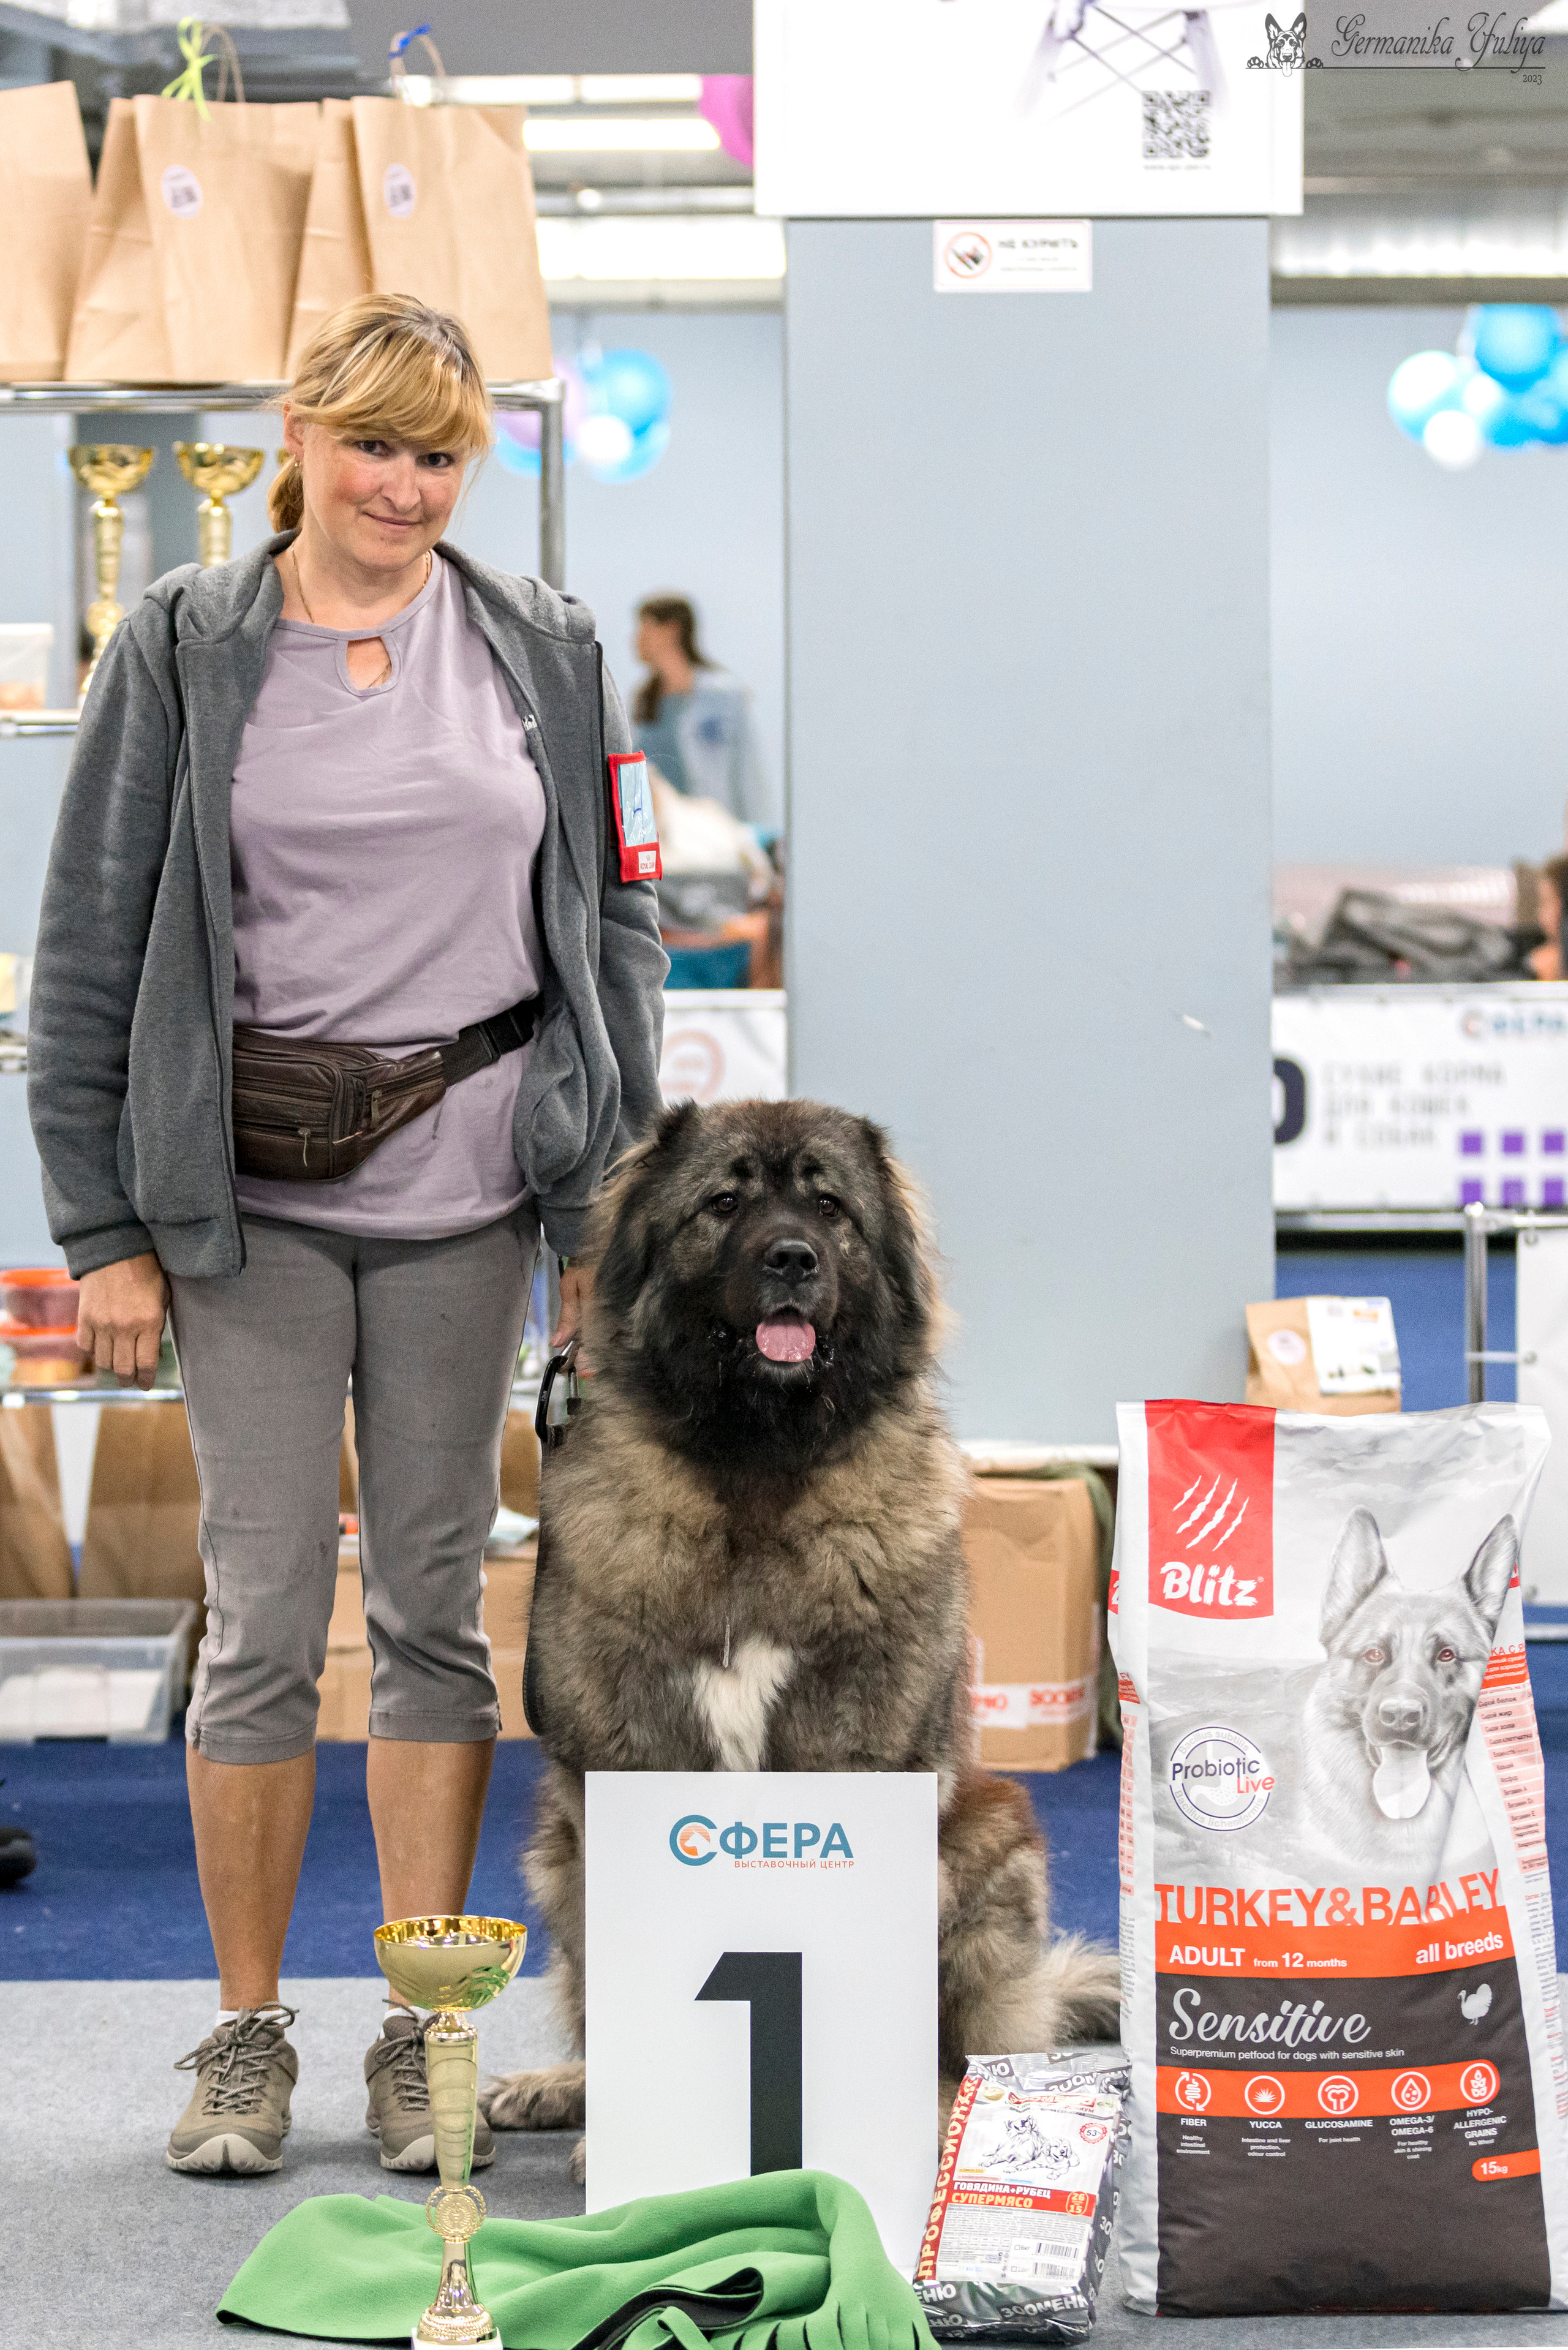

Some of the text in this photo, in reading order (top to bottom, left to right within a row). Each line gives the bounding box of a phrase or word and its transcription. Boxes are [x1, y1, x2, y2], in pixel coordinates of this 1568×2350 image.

[1179, 1731, 1250, 1755] Bacillus subtilis
[1172, 1757, 1261, 1781] Probiotic
[1237, 1776, 1276, 1795] Live
[1174, 1790, 1205, 1824] Bacillus
[669, 1814, 854, 1866] СФЕРА
[734, 1859, 854, 1870] ВЫСТАВОЧНЫЙ ЦЕНТР
[1415, 1931, 1504, 1965] all breeds
[1169, 1945, 1348, 1968] ADULT from 12 months
[1168, 1987, 1371, 2048] Sensitive
[1170, 2046, 1405, 2062] Superpremium petfood for dogs with sensitive skin
[693, 1951, 802, 2177] 1
[1389, 2115, 1435, 2126] OMEGA-3/
[1466, 2107, 1494, 2118] HYPO-
[1180, 2117, 1207, 2126] FIBER
[1249, 2120, 1283, 2129] YUCCA
[1305, 2119, 1373, 2129] GLUCOSAMINE
[1453, 2115, 1507, 2130] ALLERGENIC
[1391, 2126, 1434, 2136] OMEGA-6
[1464, 2128, 1498, 2139] GRAINS
[1480, 2161, 1509, 2175] 15kg
[953, 2181, 1051, 2199] ГОВЯДИНА+РУБЕЦ
[1071, 2193, 1085, 2201] 26
[951, 2192, 1033, 2208] СУПЕРМЯСО
